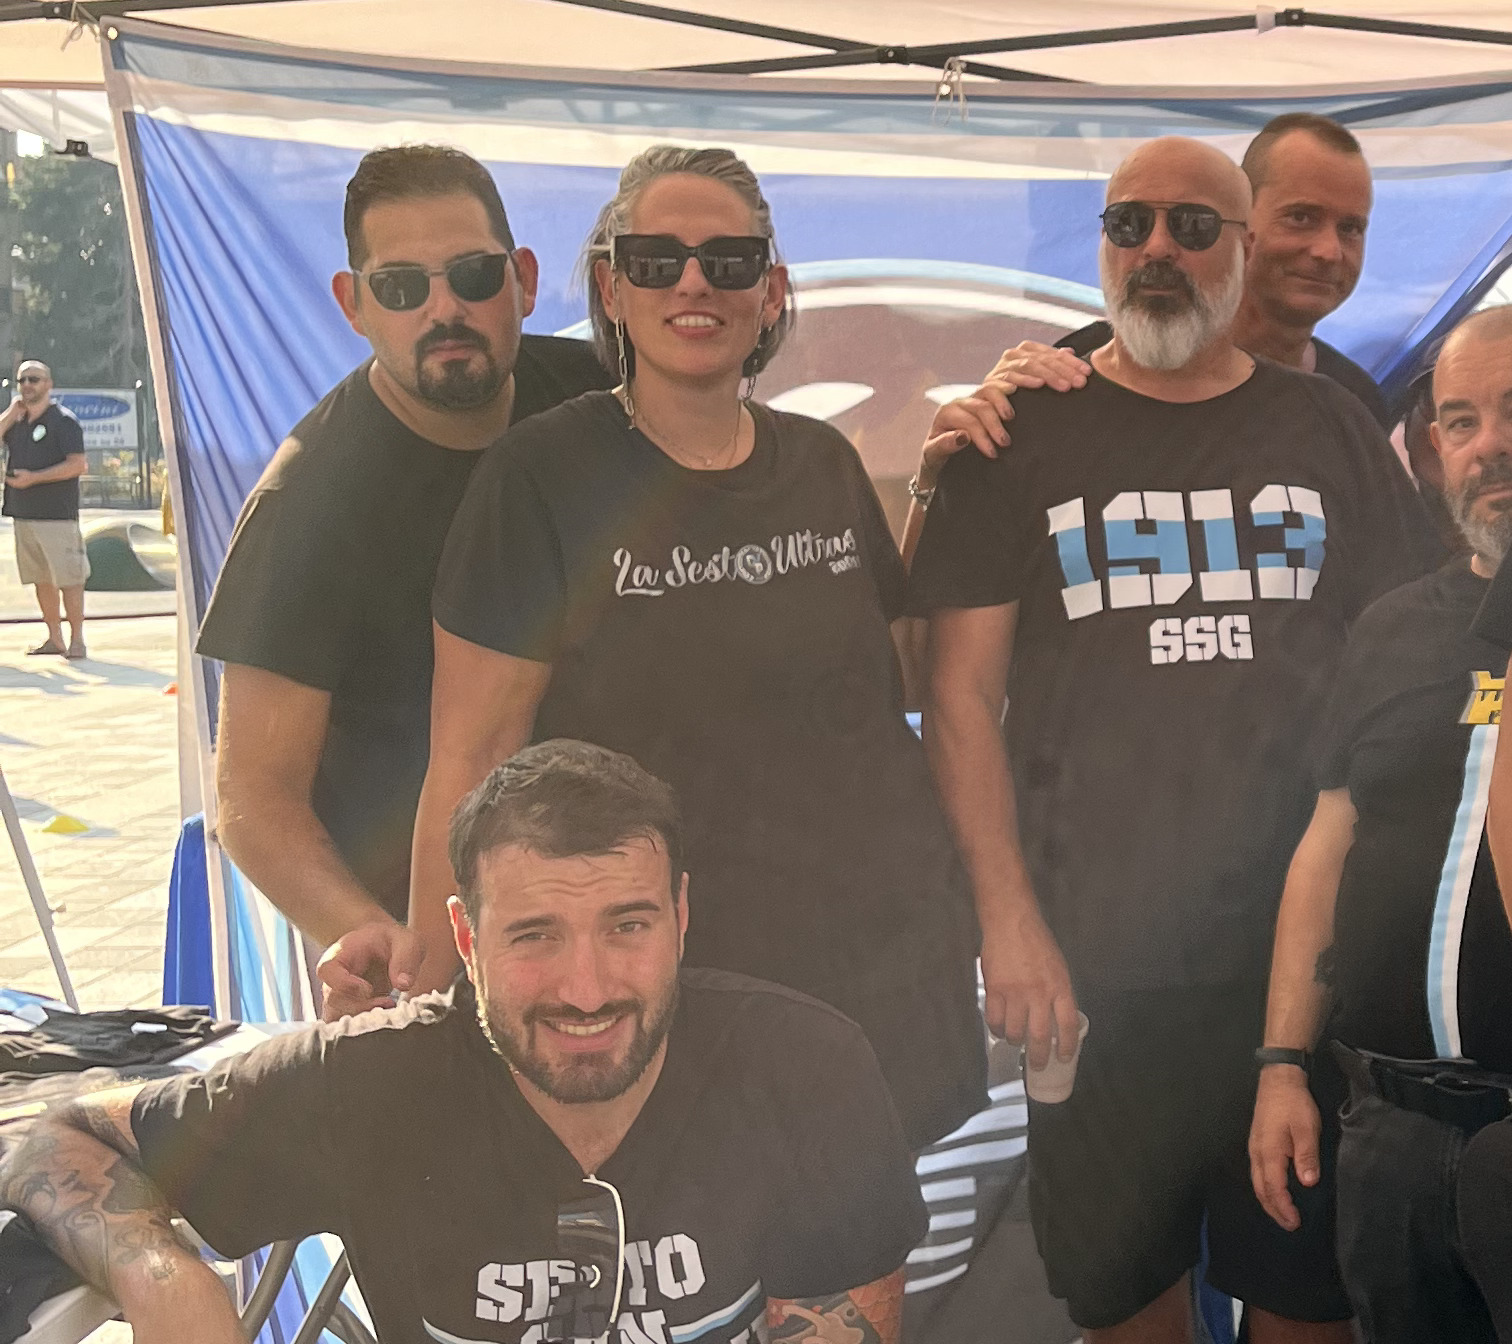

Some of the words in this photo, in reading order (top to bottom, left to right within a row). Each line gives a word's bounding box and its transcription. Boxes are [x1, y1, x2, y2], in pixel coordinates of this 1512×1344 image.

[613, 547, 665, 597] La
[770, 528, 857, 575] Ultras
[1047, 484, 1327, 620] 1913
[1149, 614, 1254, 665] SSG
[475, 1233, 706, 1323] SETO
